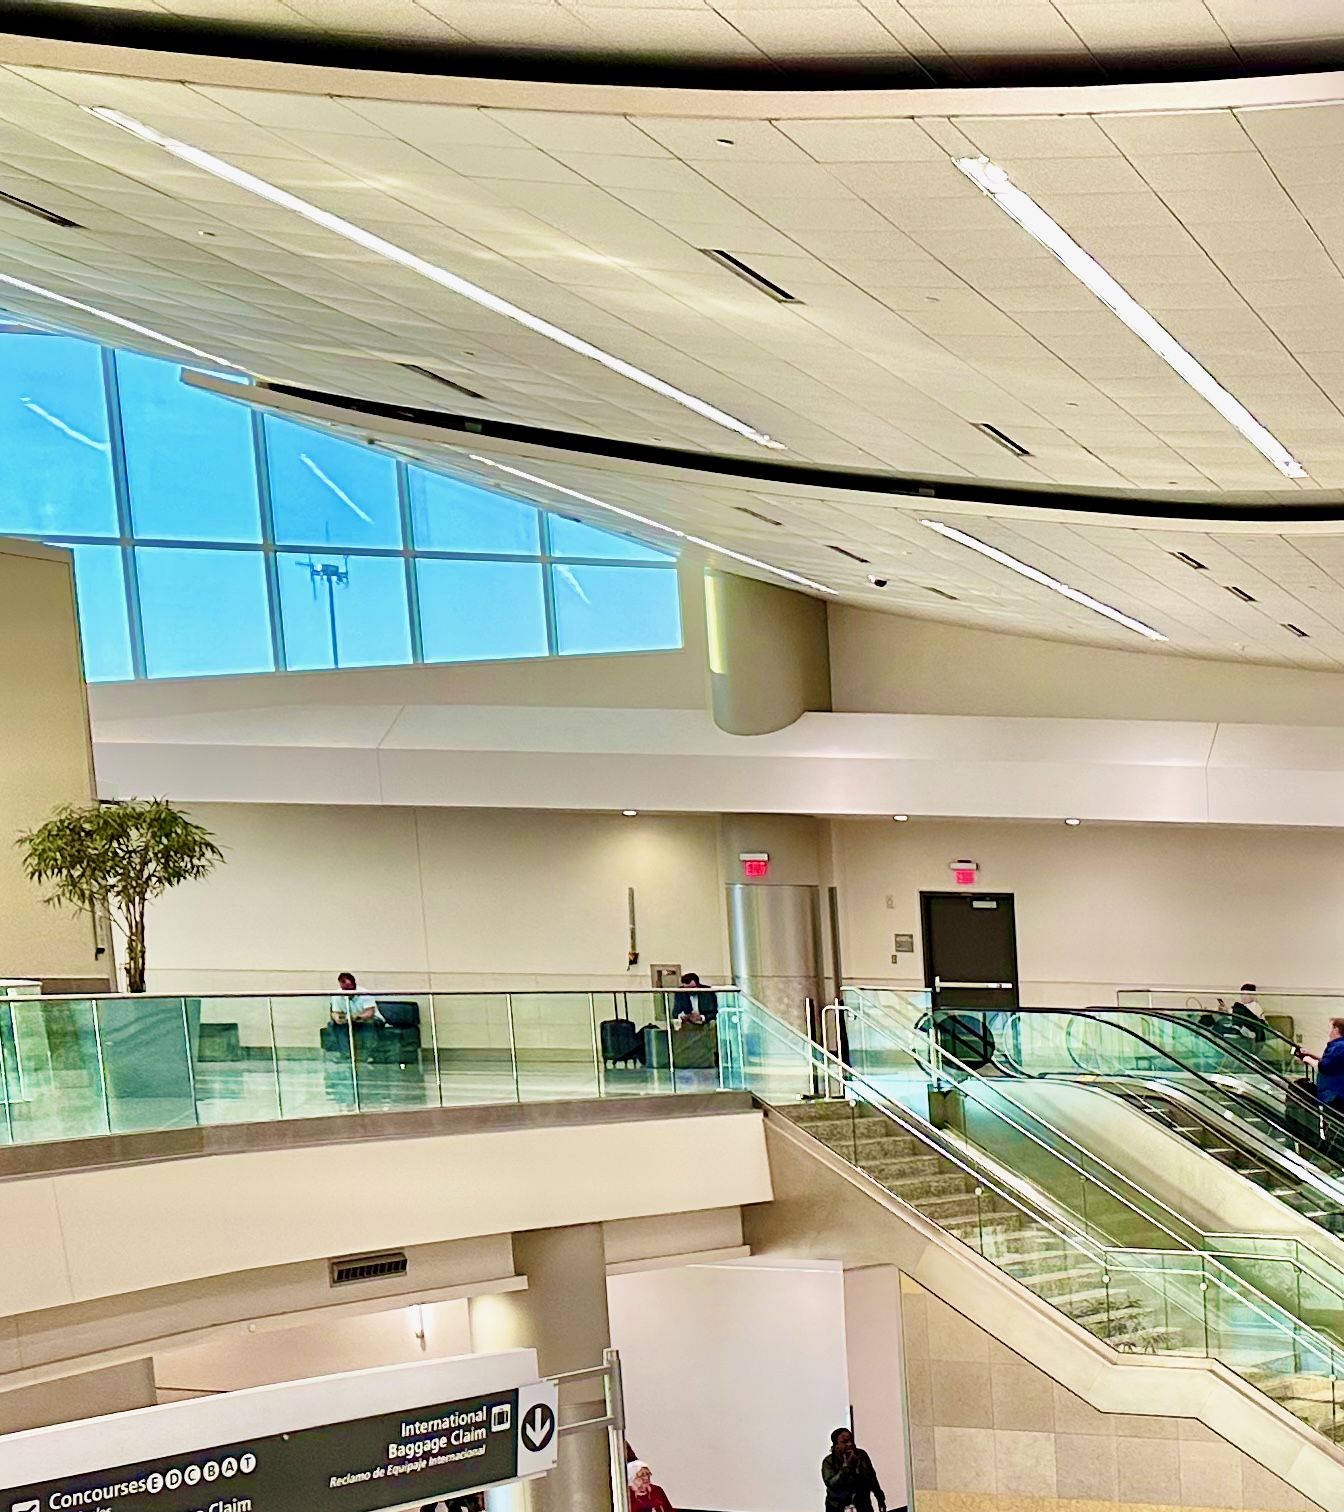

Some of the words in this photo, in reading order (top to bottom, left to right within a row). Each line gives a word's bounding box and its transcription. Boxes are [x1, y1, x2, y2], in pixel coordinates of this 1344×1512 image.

[401, 1406, 487, 1438] International
[388, 1434, 447, 1460] Baggage
[450, 1426, 487, 1446] Claim
[329, 1471, 371, 1489] Reclamo
[372, 1466, 386, 1479] de
[386, 1458, 428, 1478] Equipaje
[428, 1445, 486, 1467] Internacional
[49, 1476, 147, 1511] Concourses
